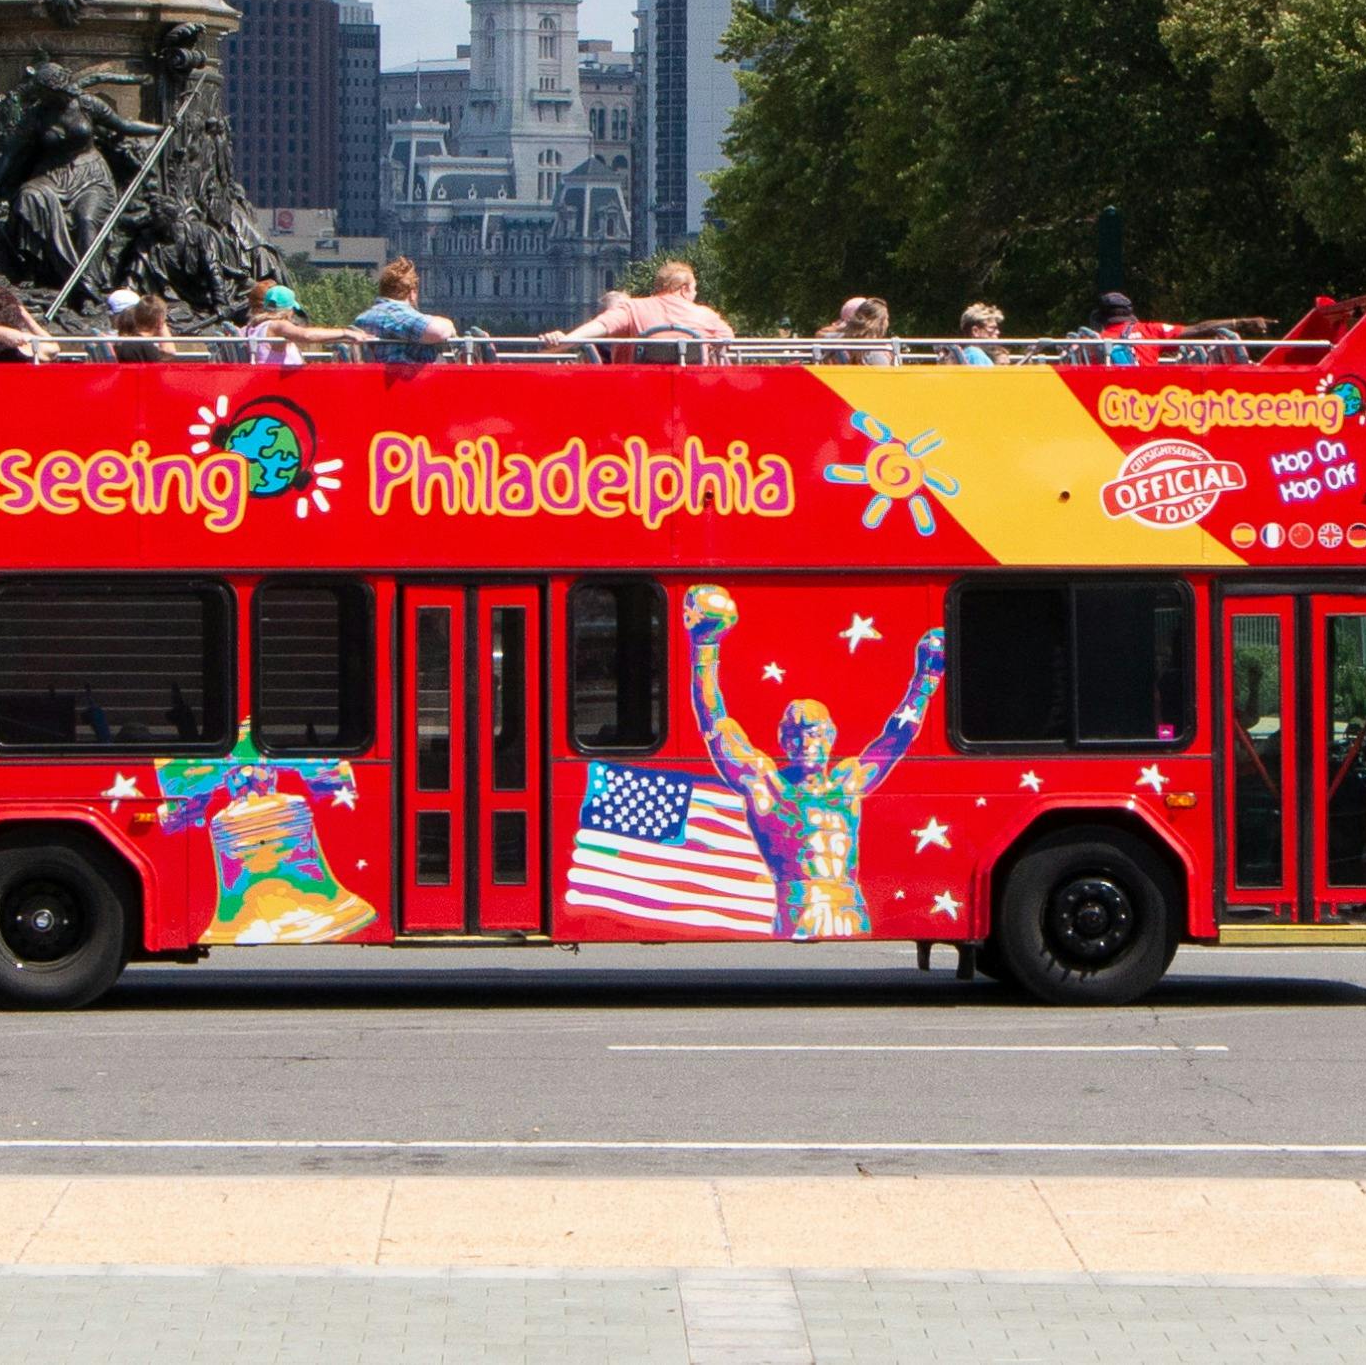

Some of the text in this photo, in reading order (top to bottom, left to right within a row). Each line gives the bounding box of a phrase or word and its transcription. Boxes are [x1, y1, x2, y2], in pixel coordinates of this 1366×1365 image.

[1271, 439, 1346, 475] Hop On
[369, 431, 795, 530] Philadelphia
[1115, 466, 1238, 510] OFFICIAL
[1279, 463, 1357, 502] Hop Off
[1154, 497, 1211, 522] TOUR
